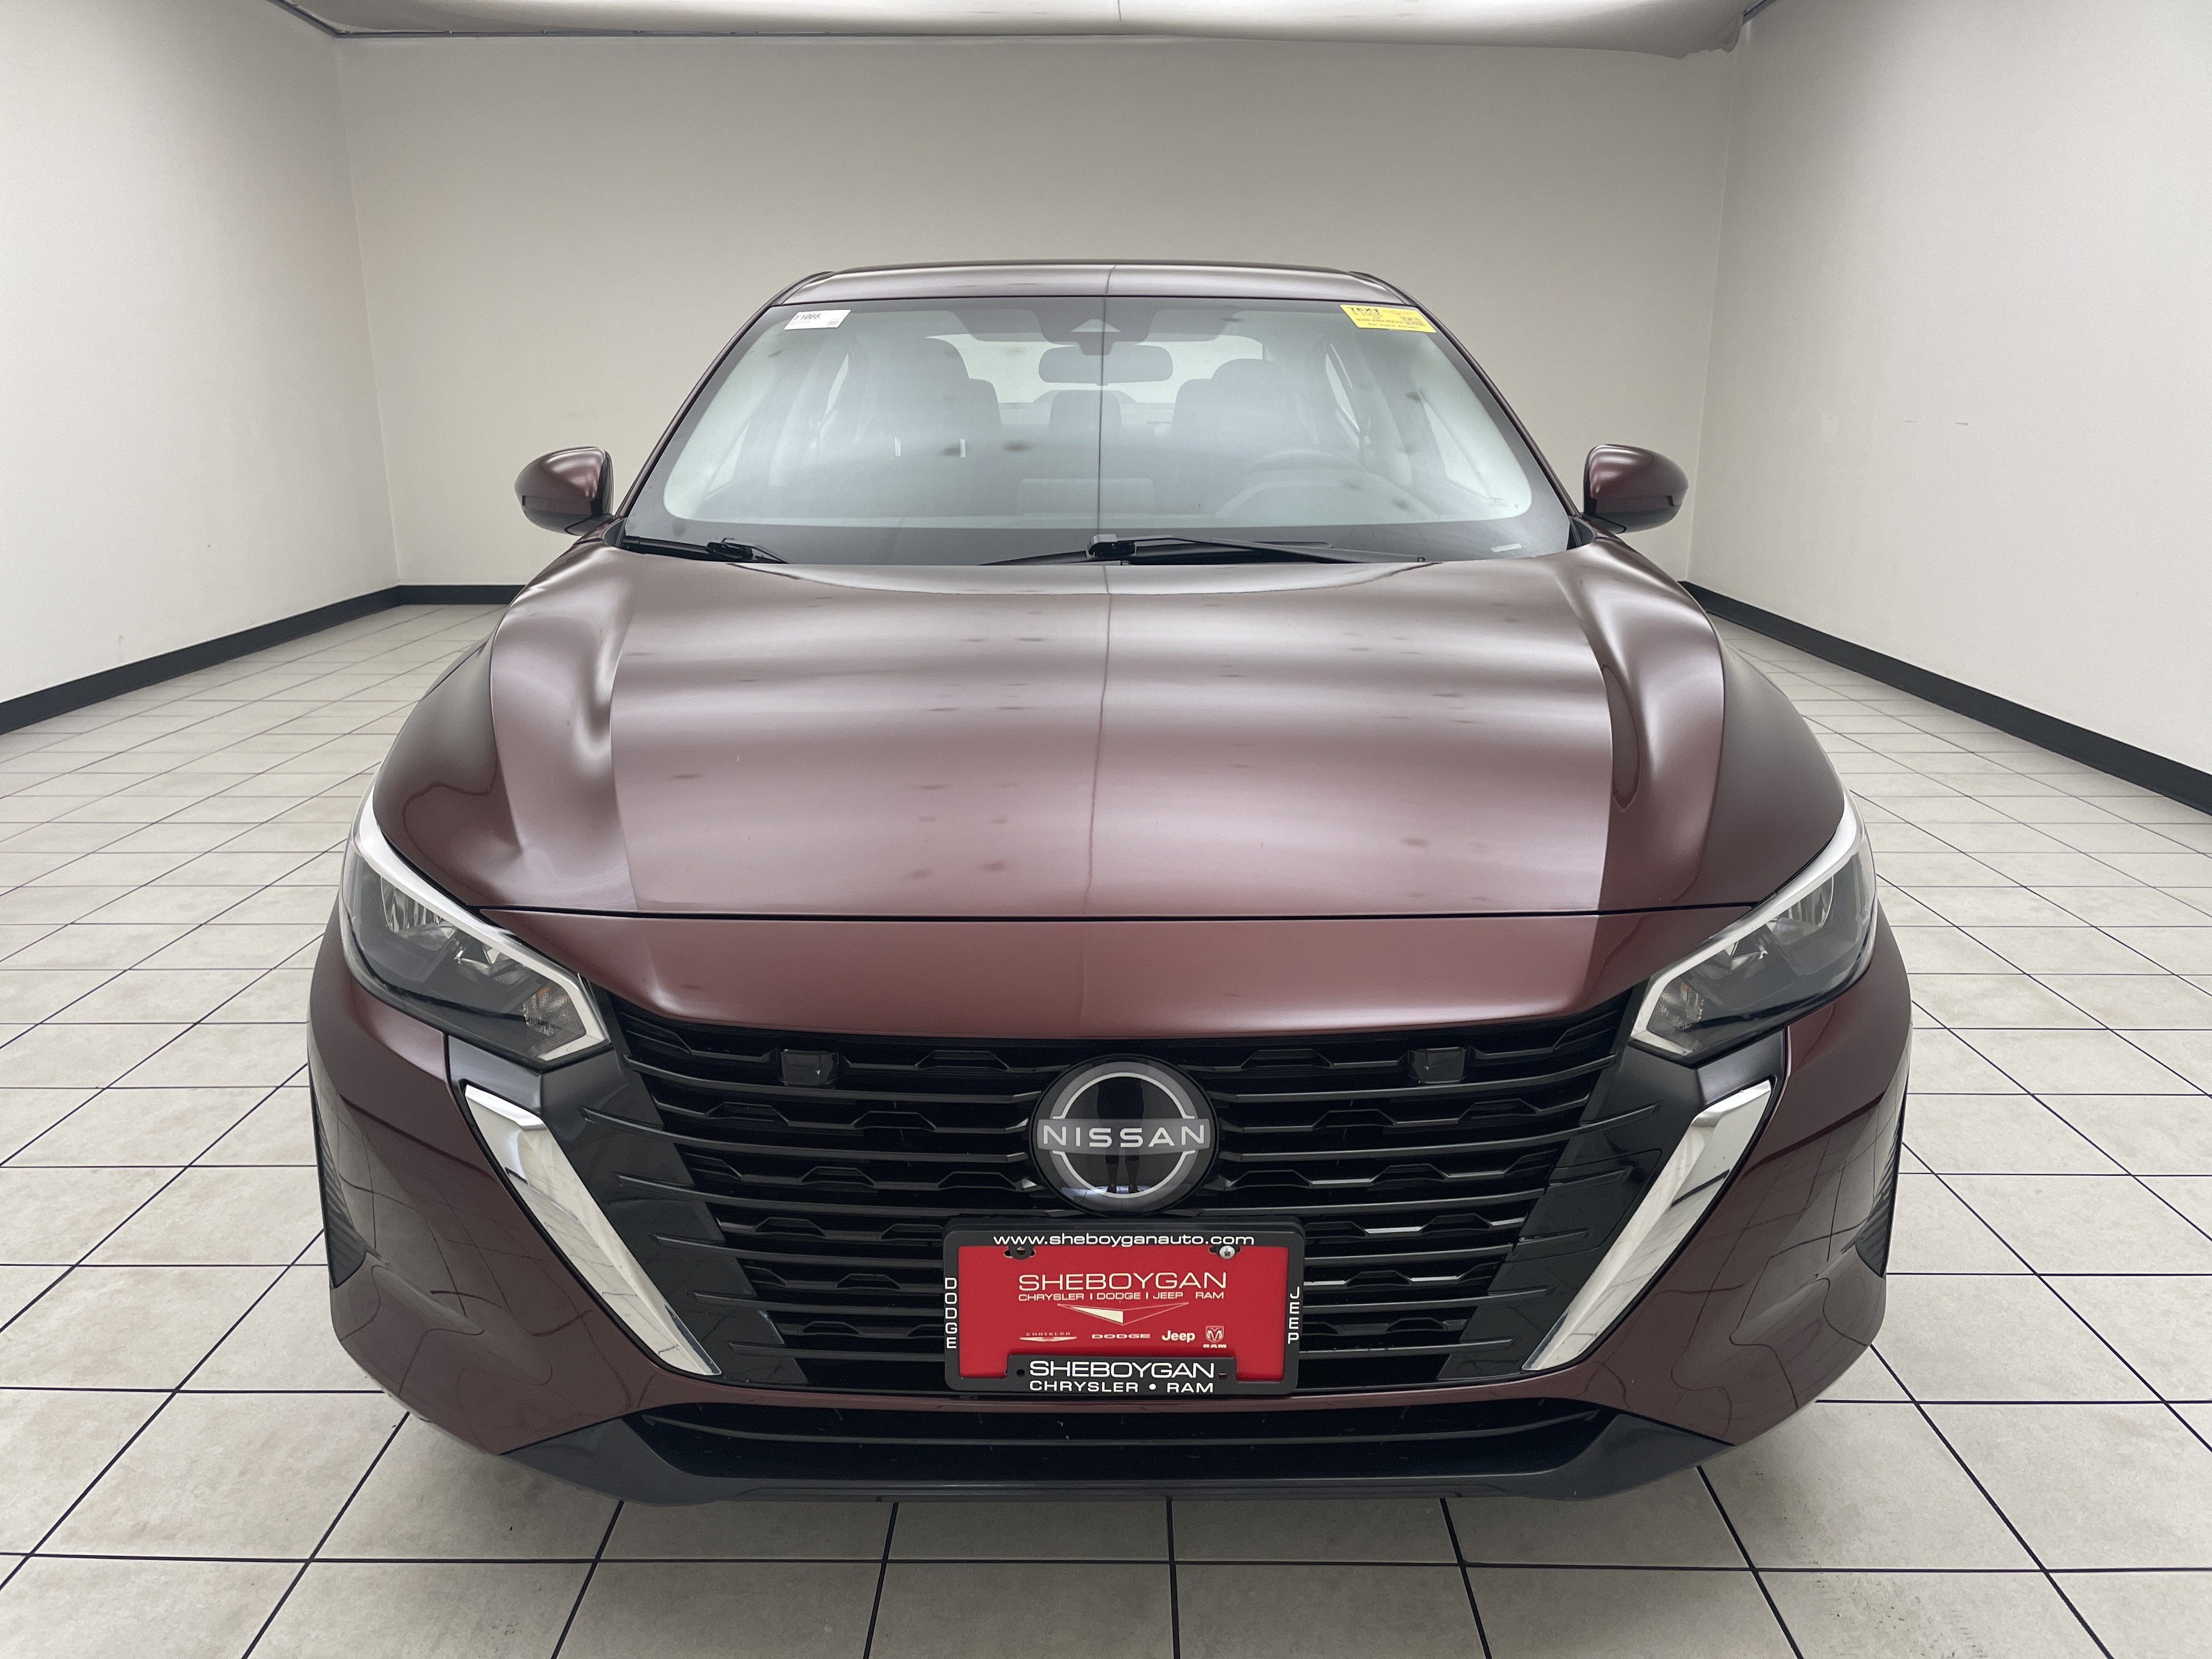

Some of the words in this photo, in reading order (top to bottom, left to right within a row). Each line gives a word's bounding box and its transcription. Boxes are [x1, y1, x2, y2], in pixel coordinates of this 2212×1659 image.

[1043, 1125, 1205, 1148] NISSAN
[993, 1233, 1255, 1247] www.sheboyganauto.com
[1018, 1272, 1227, 1291] SHEBOYGAN
[1018, 1293, 1084, 1301] CHRYSLER
[1195, 1291, 1224, 1300] RAM
[944, 1277, 958, 1349] DODGE
[1288, 1286, 1300, 1345] JEEP
[1161, 1330, 1195, 1343] Jeep
[1029, 1360, 1215, 1379] SHEBOYGAN
[1029, 1380, 1138, 1393] CHRYSLER
[1166, 1382, 1214, 1393] RAM
